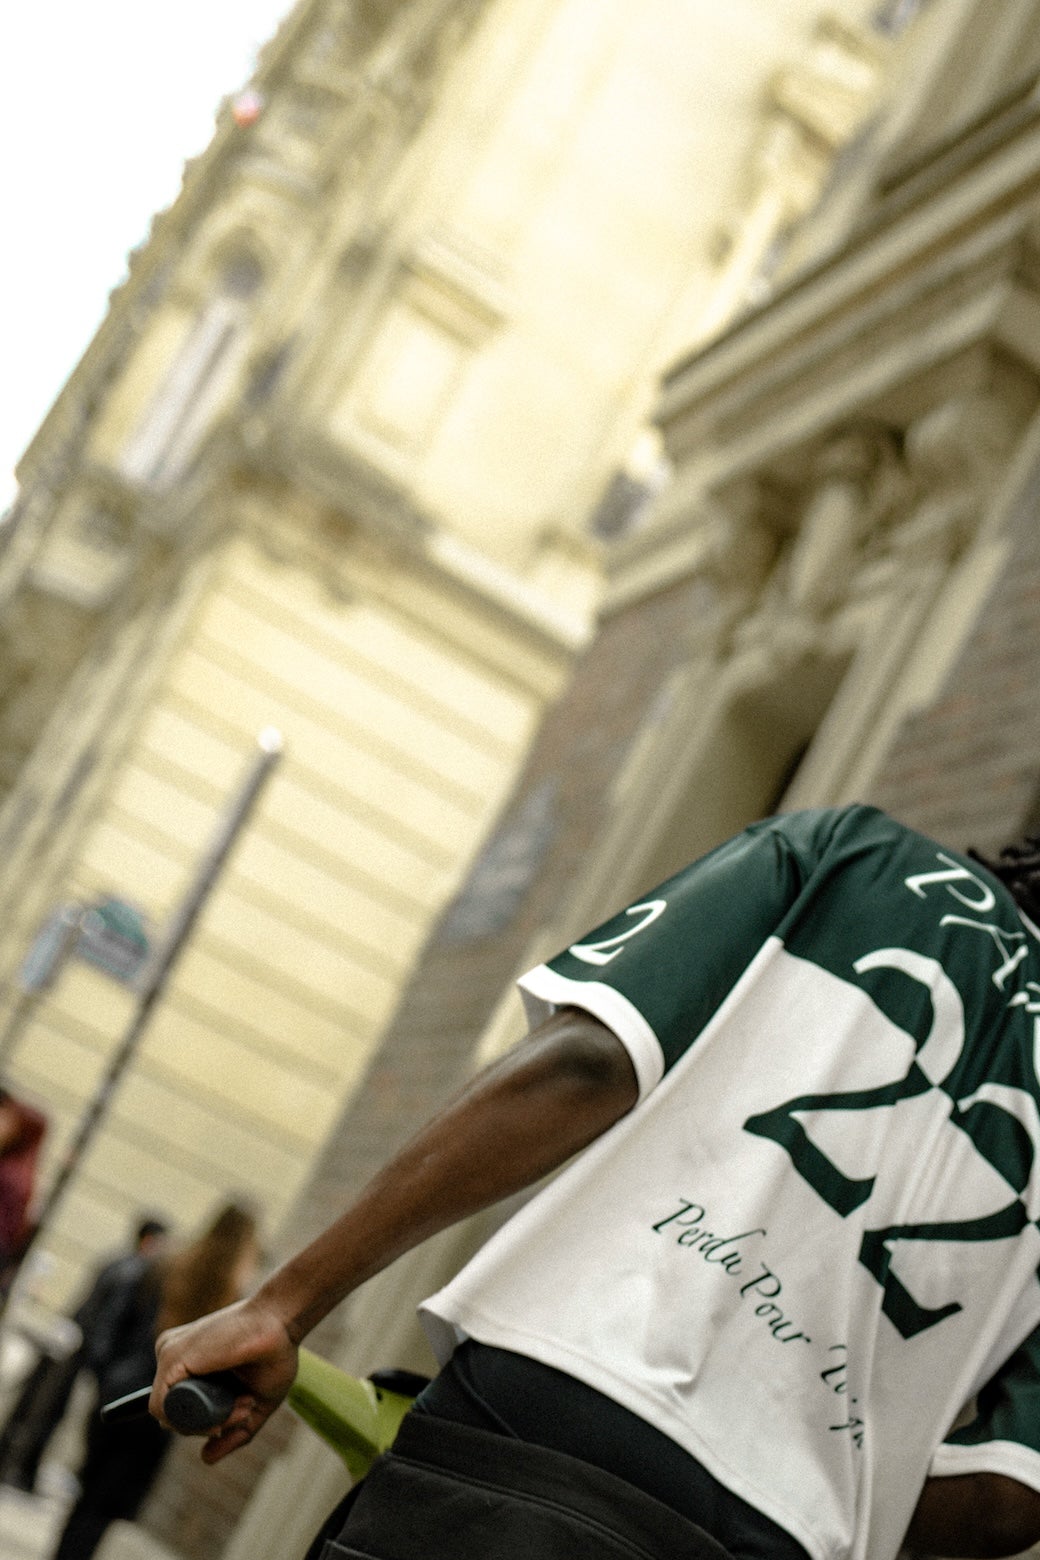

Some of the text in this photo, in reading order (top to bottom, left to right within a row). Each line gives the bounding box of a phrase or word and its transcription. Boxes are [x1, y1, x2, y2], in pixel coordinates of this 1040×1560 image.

[568, 899, 667, 966] 2
[652, 1197, 811, 1343] Perdu Pour
